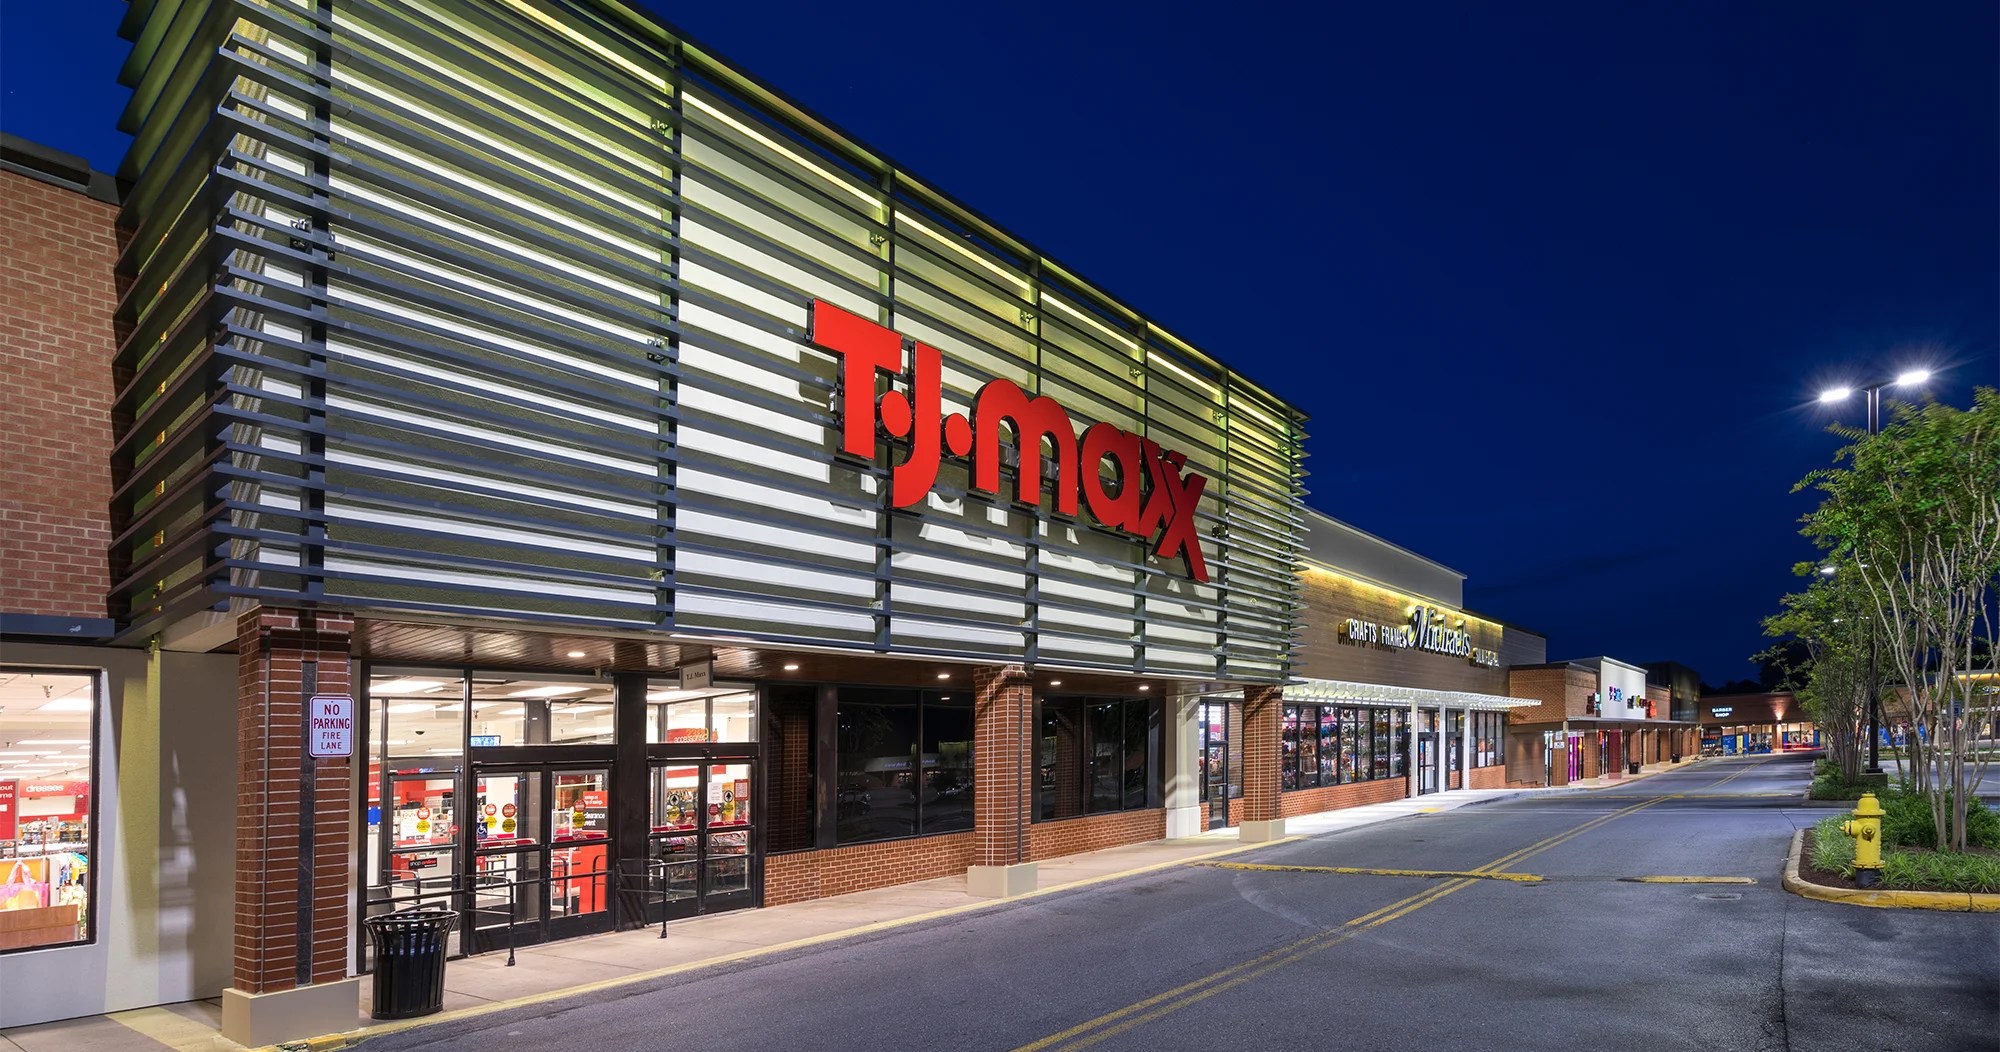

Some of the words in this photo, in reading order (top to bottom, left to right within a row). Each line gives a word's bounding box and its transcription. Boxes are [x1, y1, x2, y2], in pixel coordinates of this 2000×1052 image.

[1350, 618, 1377, 643] CRAFTS
[1381, 625, 1408, 649] FRAMES
[1408, 605, 1471, 657] Michaels
[324, 704, 340, 716] NO
[313, 718, 350, 729] PARKING
[322, 732, 341, 740] FIRE
[320, 742, 342, 750] LANE
[26, 785, 64, 793] dresses
